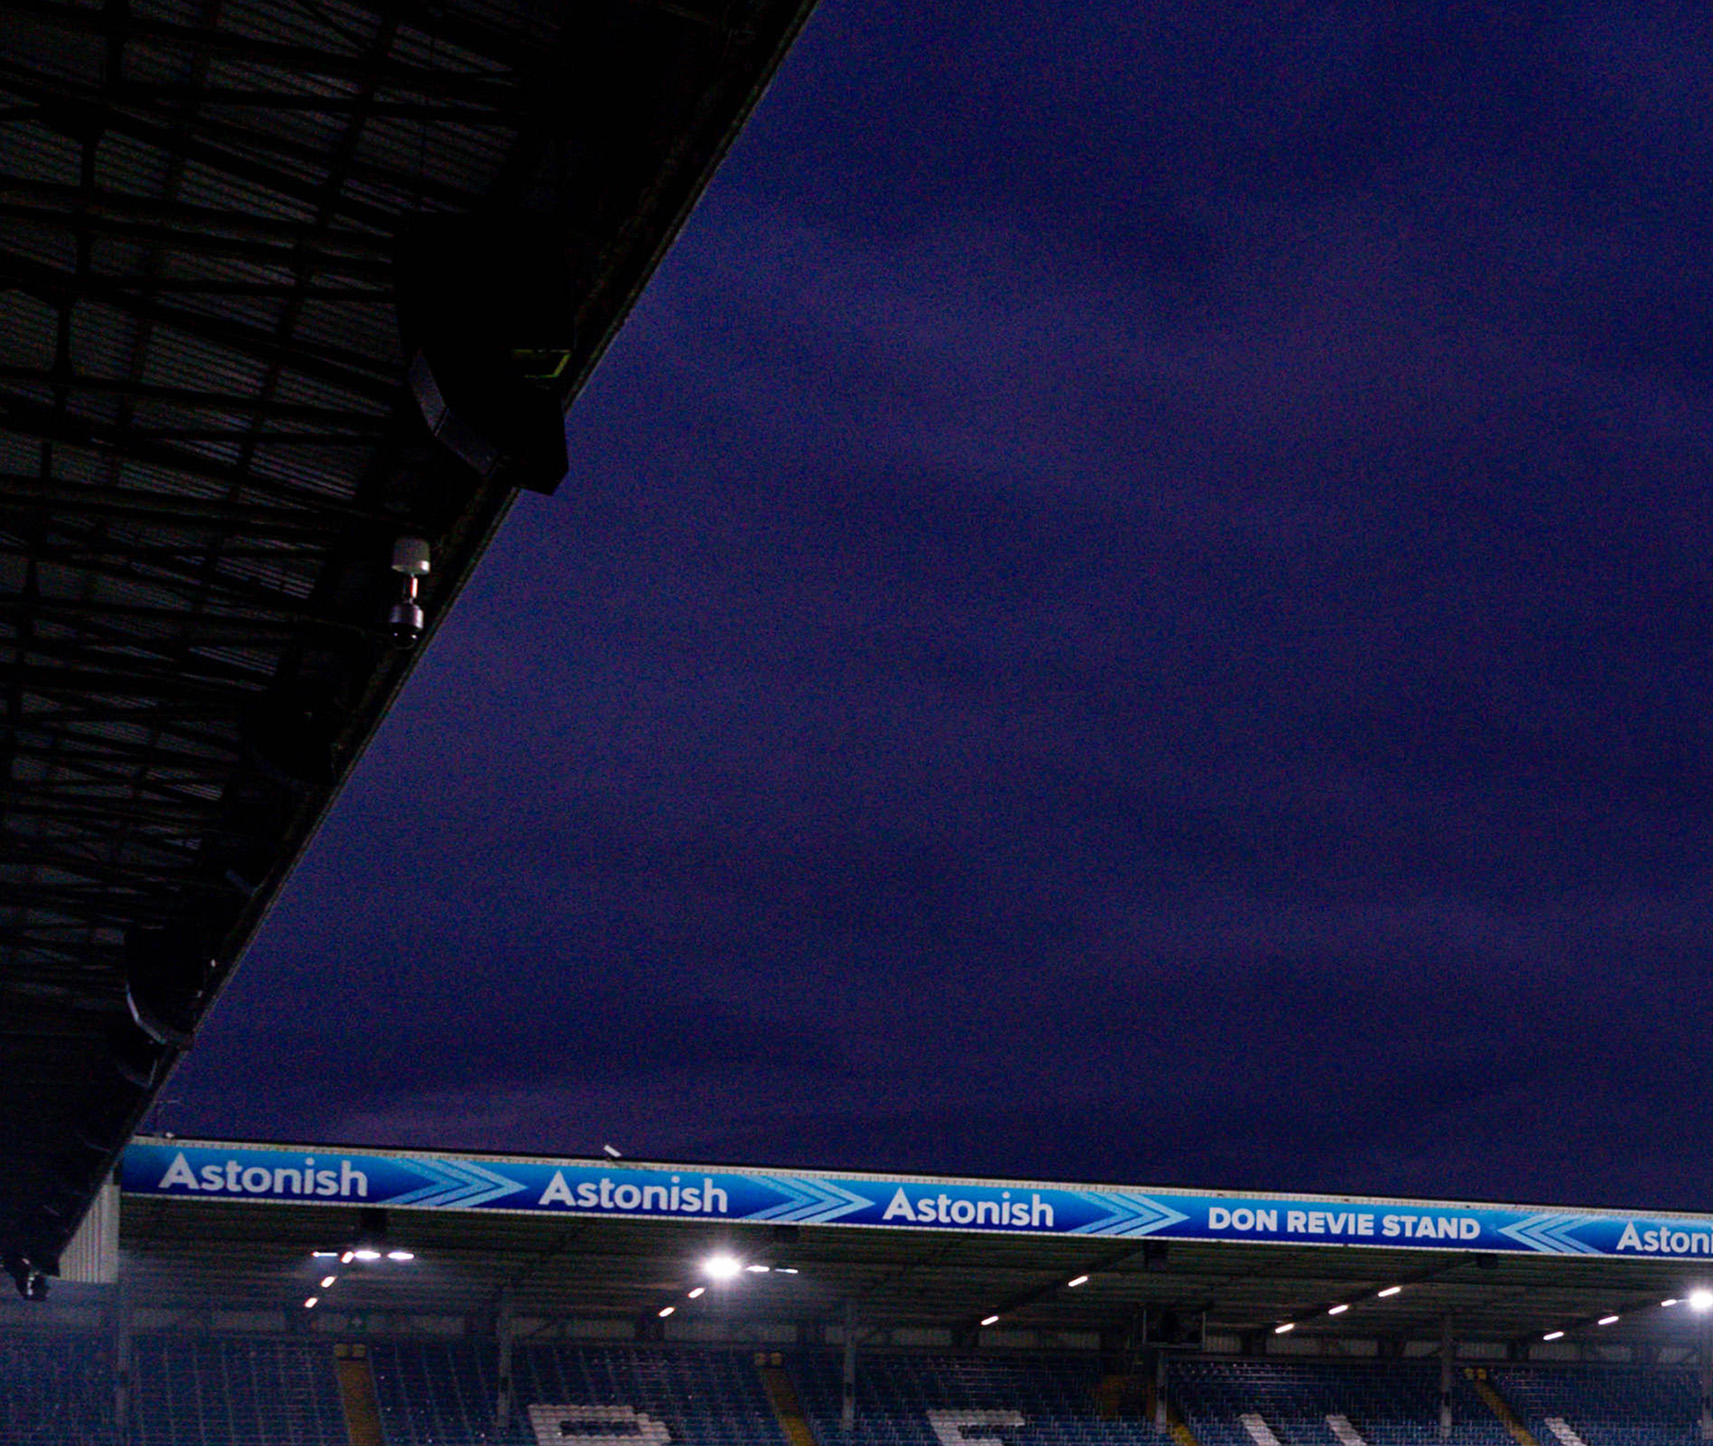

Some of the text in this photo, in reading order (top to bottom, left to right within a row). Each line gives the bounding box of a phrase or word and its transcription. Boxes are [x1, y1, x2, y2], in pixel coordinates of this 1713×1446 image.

[157, 1151, 369, 1198] Astonish
[538, 1168, 729, 1214] Astonish
[882, 1185, 1055, 1229] Astonish
[1208, 1206, 1482, 1241] DON REVIE STAND
